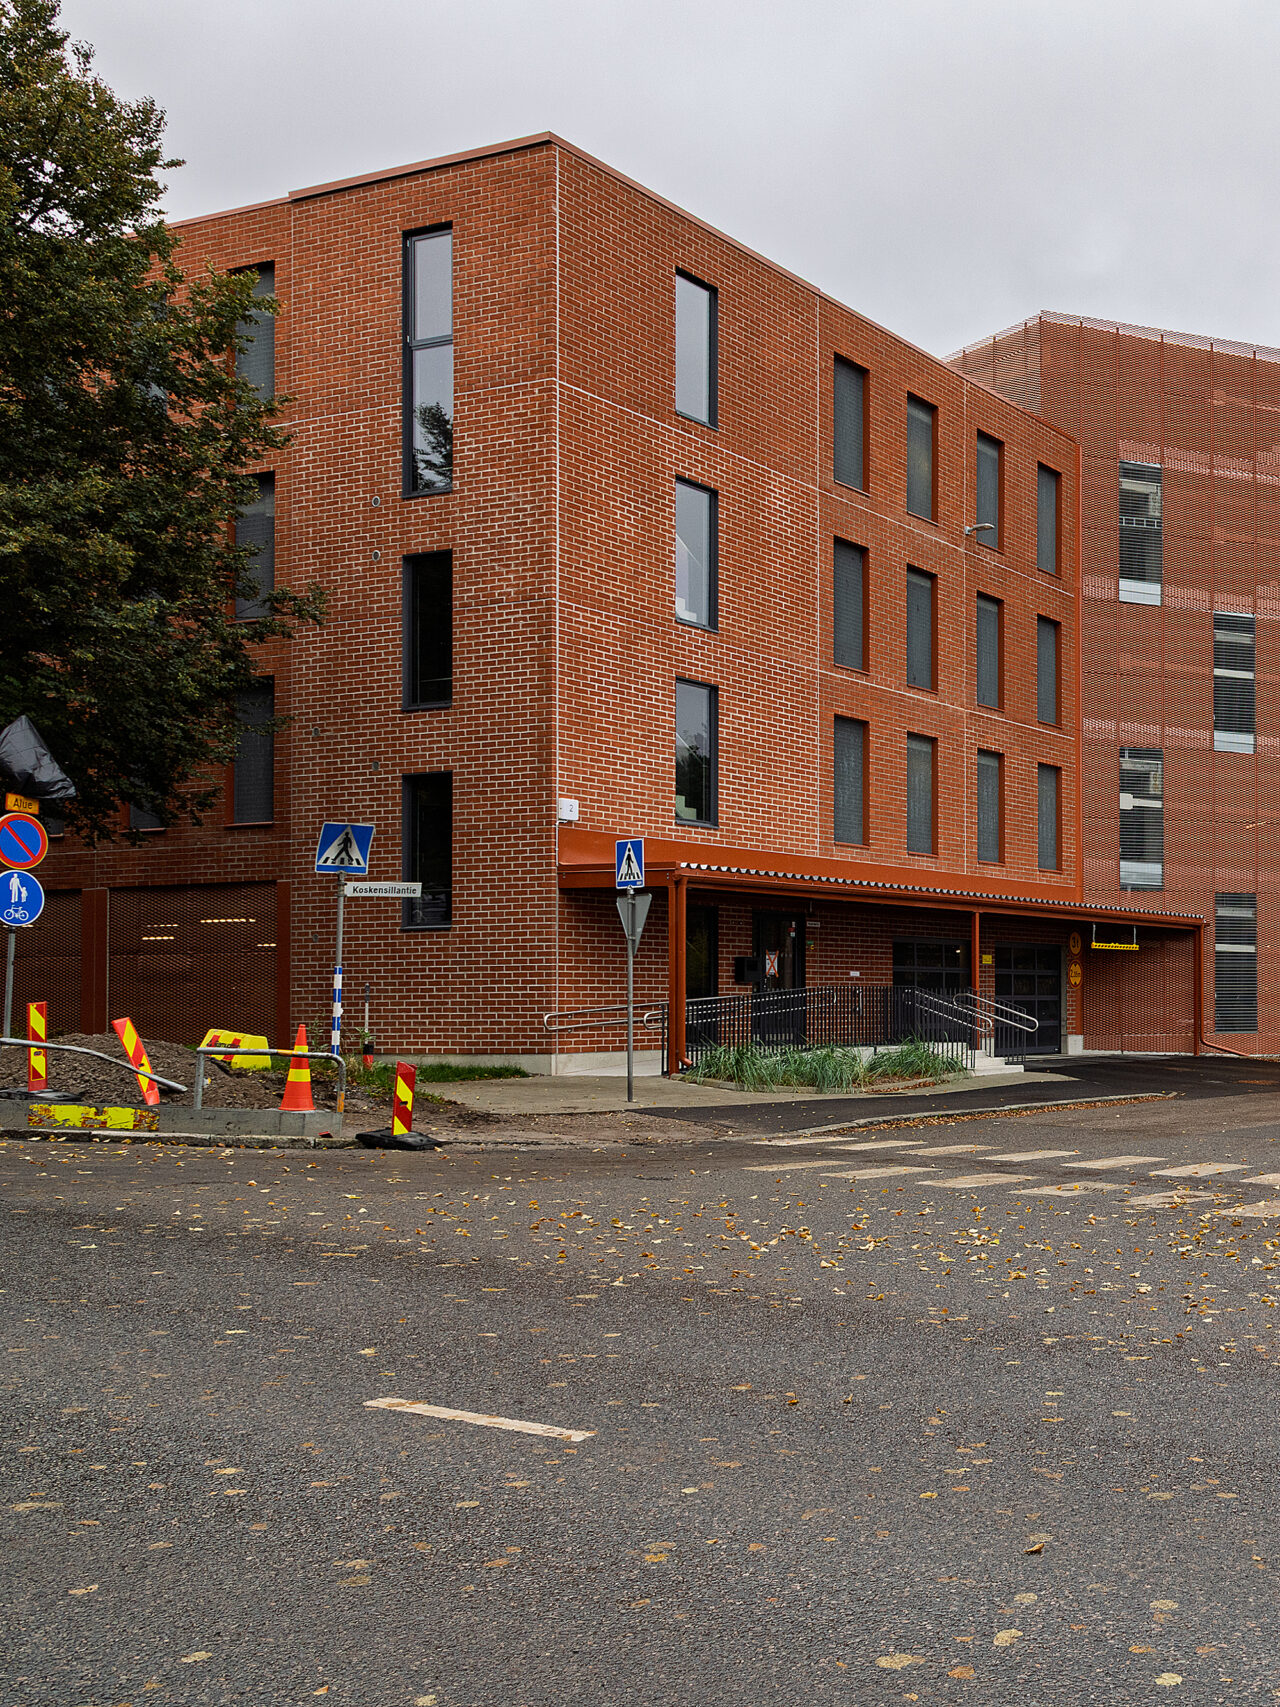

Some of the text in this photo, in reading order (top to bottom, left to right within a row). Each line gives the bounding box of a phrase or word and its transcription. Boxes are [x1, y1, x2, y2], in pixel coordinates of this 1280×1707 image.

[13, 797, 33, 810] Alue
[569, 804, 574, 813] 2
[352, 885, 417, 895] Koskensillantie
